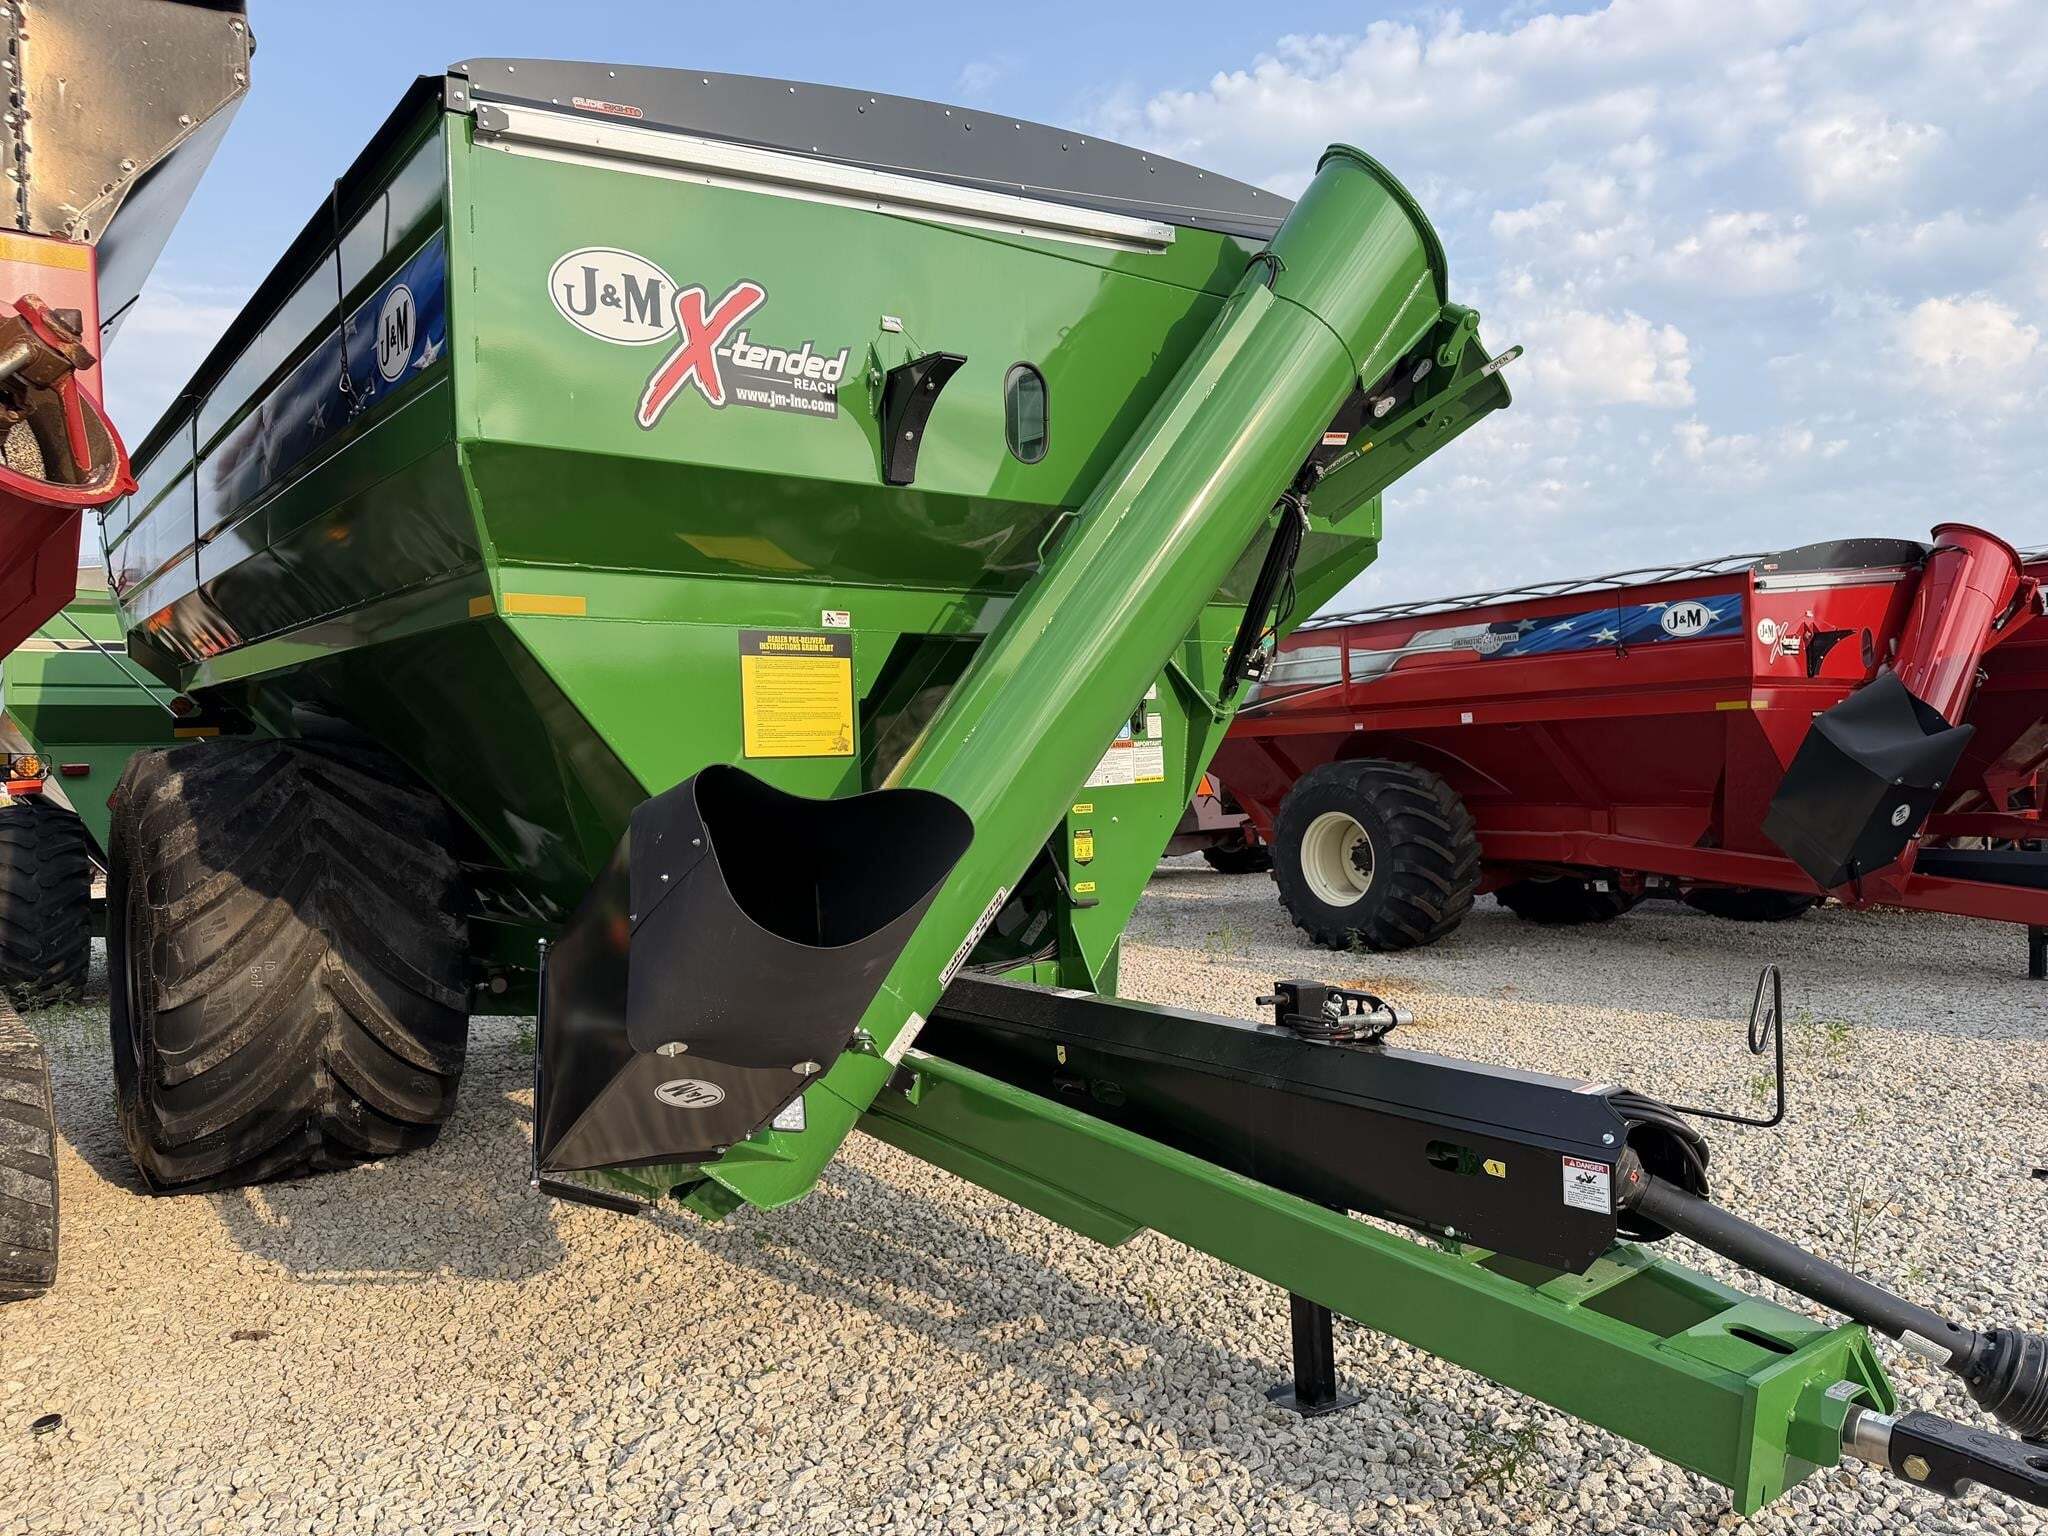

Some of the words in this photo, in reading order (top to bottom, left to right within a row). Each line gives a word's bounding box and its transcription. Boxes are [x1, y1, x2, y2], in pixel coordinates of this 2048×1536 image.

[563, 266, 664, 329] J&M
[381, 300, 409, 367] J&M
[1489, 355, 1509, 370] OPEN
[793, 377, 836, 395] REACH
[736, 386, 836, 414] www.jm-inc.com
[1667, 608, 1702, 630] J&M
[662, 1082, 718, 1104] J&M
[1575, 1161, 1605, 1173] DANGER
